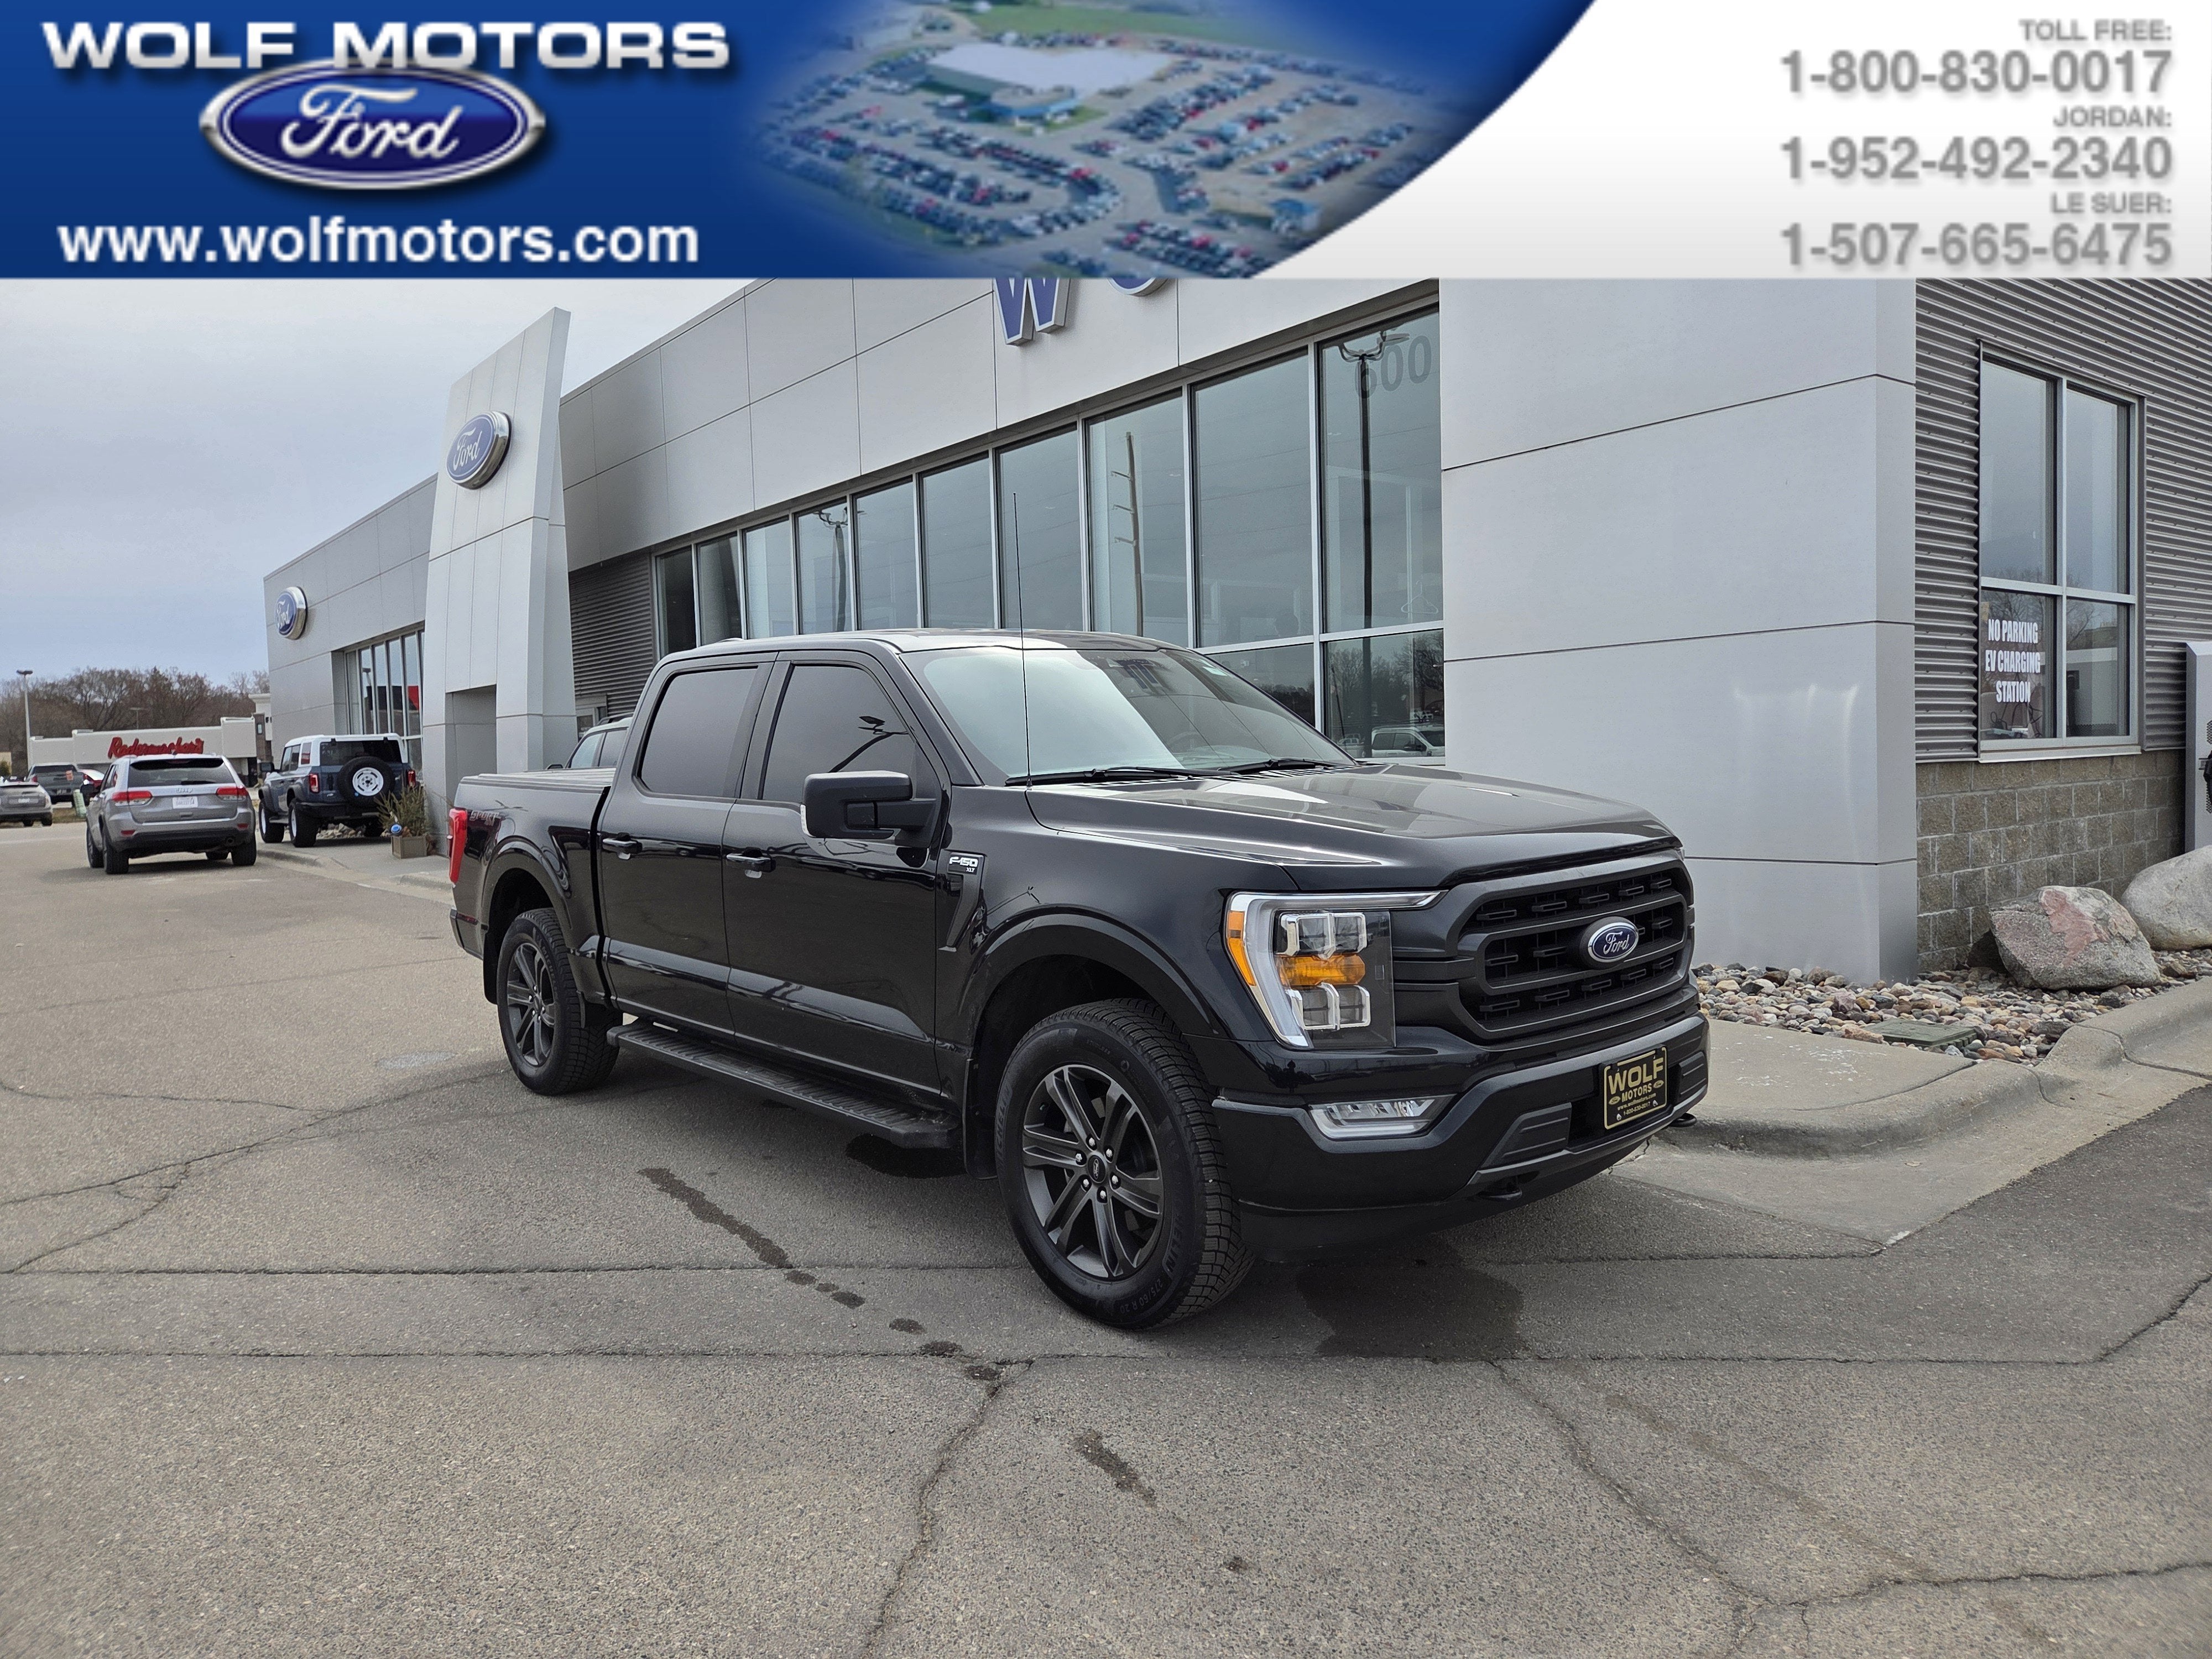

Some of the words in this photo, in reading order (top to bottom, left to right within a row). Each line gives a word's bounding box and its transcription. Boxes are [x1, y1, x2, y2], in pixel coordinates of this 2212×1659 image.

[452, 427, 483, 471] Ford
[277, 600, 290, 627] Ford
[1988, 619, 2000, 641] NO
[2001, 620, 2038, 644] PARKING
[1985, 650, 1996, 672] EV
[1997, 651, 2041, 674] CHARGING
[1996, 680, 2031, 703] STATION
[949, 857, 979, 867] F-150
[1603, 931, 1630, 955] Ford
[1608, 1057, 1664, 1094] WOLF
[1621, 1083, 1652, 1102] MOTORS
